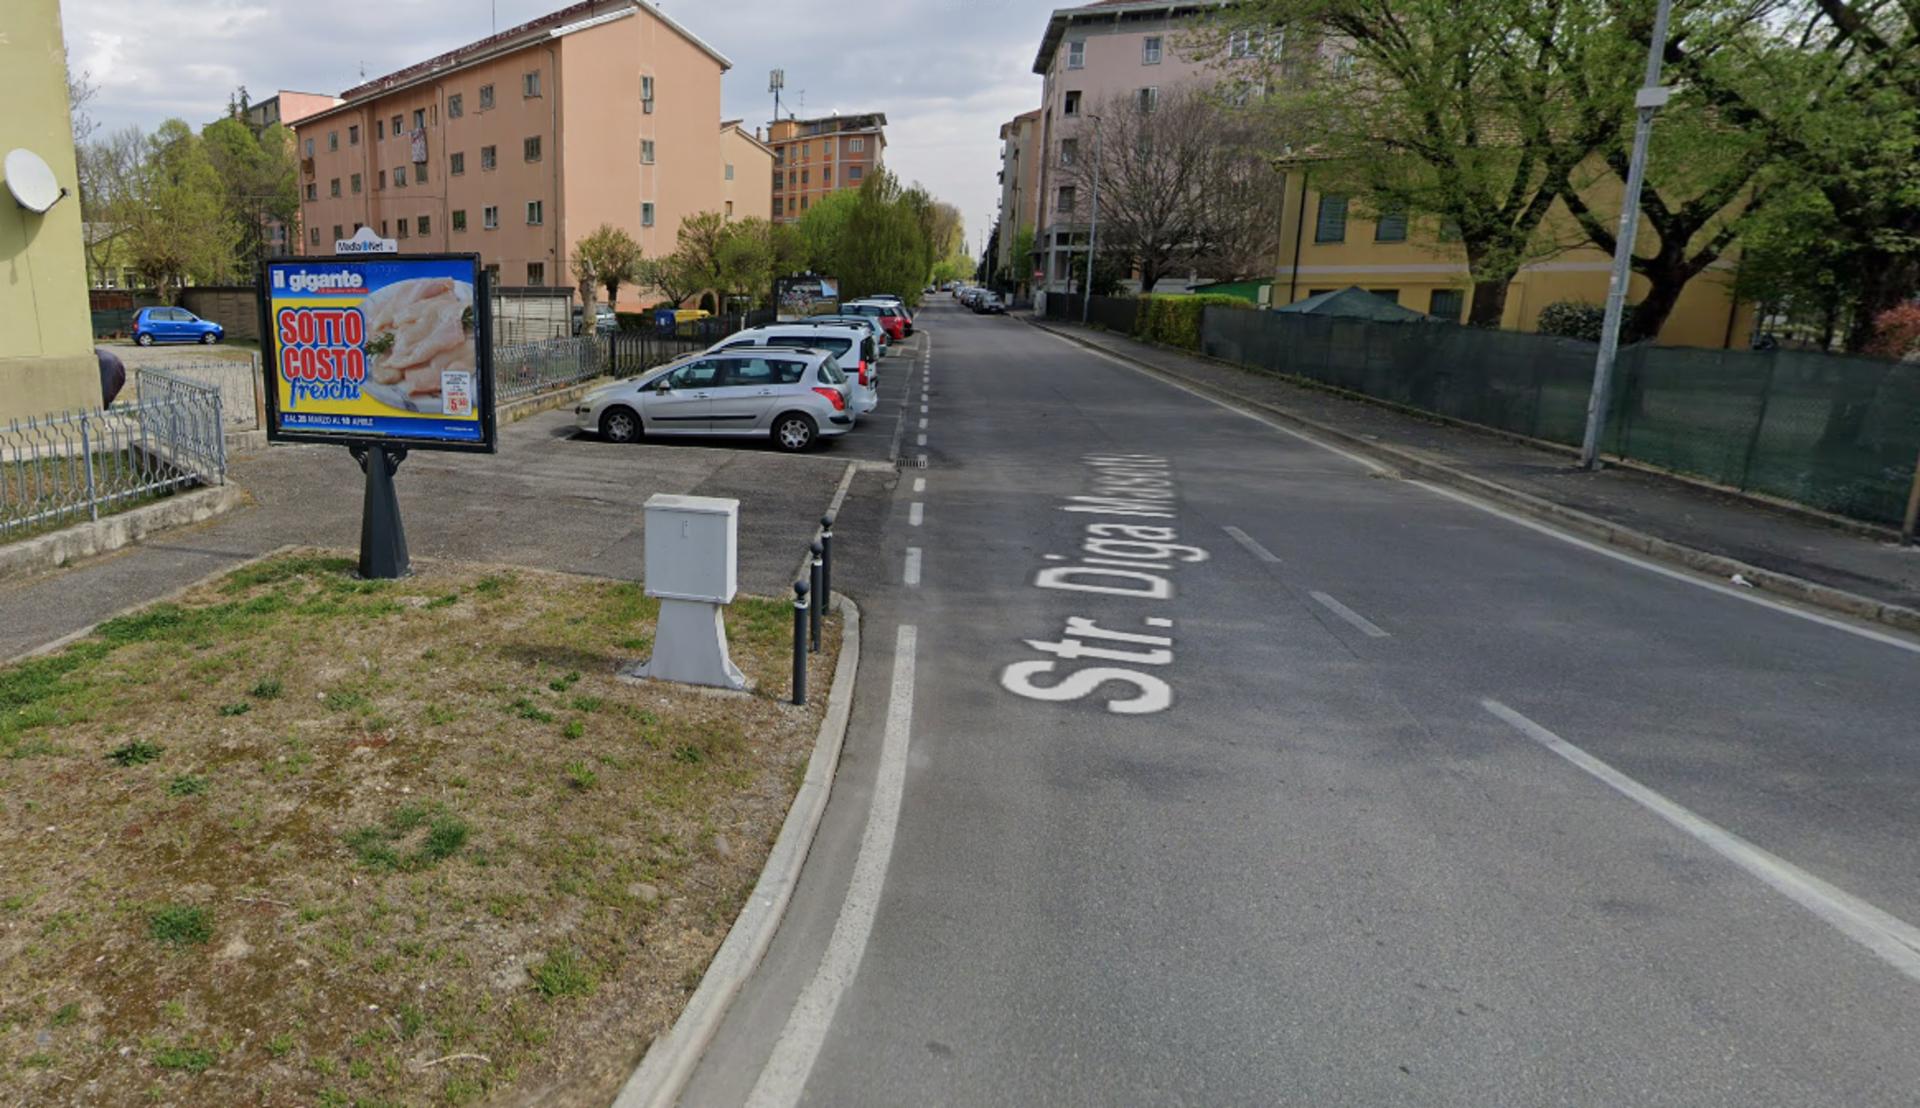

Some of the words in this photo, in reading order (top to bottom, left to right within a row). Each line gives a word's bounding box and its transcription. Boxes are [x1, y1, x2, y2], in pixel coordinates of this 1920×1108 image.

[273, 270, 285, 288] il
[290, 270, 363, 293] gigante
[280, 309, 362, 346] SOTTO
[284, 347, 364, 382] COSTO
[290, 377, 360, 408] freschi
